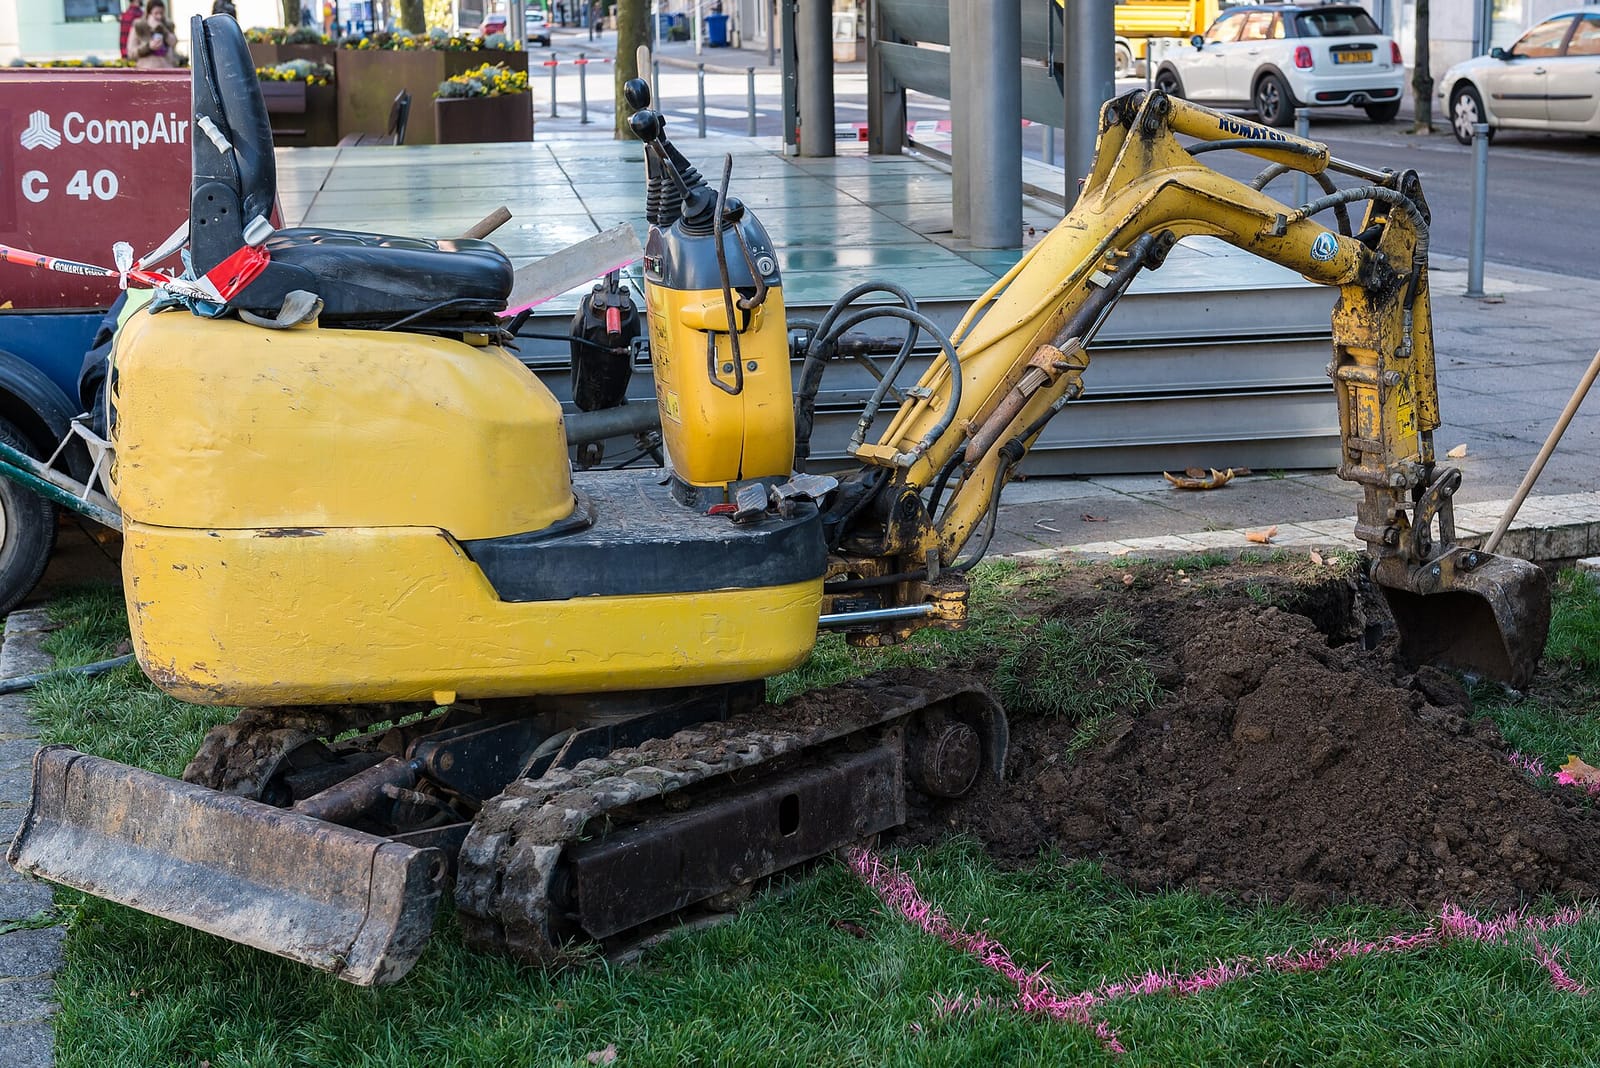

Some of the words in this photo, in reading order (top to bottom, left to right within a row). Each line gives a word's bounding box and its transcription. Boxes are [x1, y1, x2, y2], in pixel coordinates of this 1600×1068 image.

[63, 111, 189, 150] CompAir
[21, 170, 49, 203] C
[66, 169, 119, 201] 40
